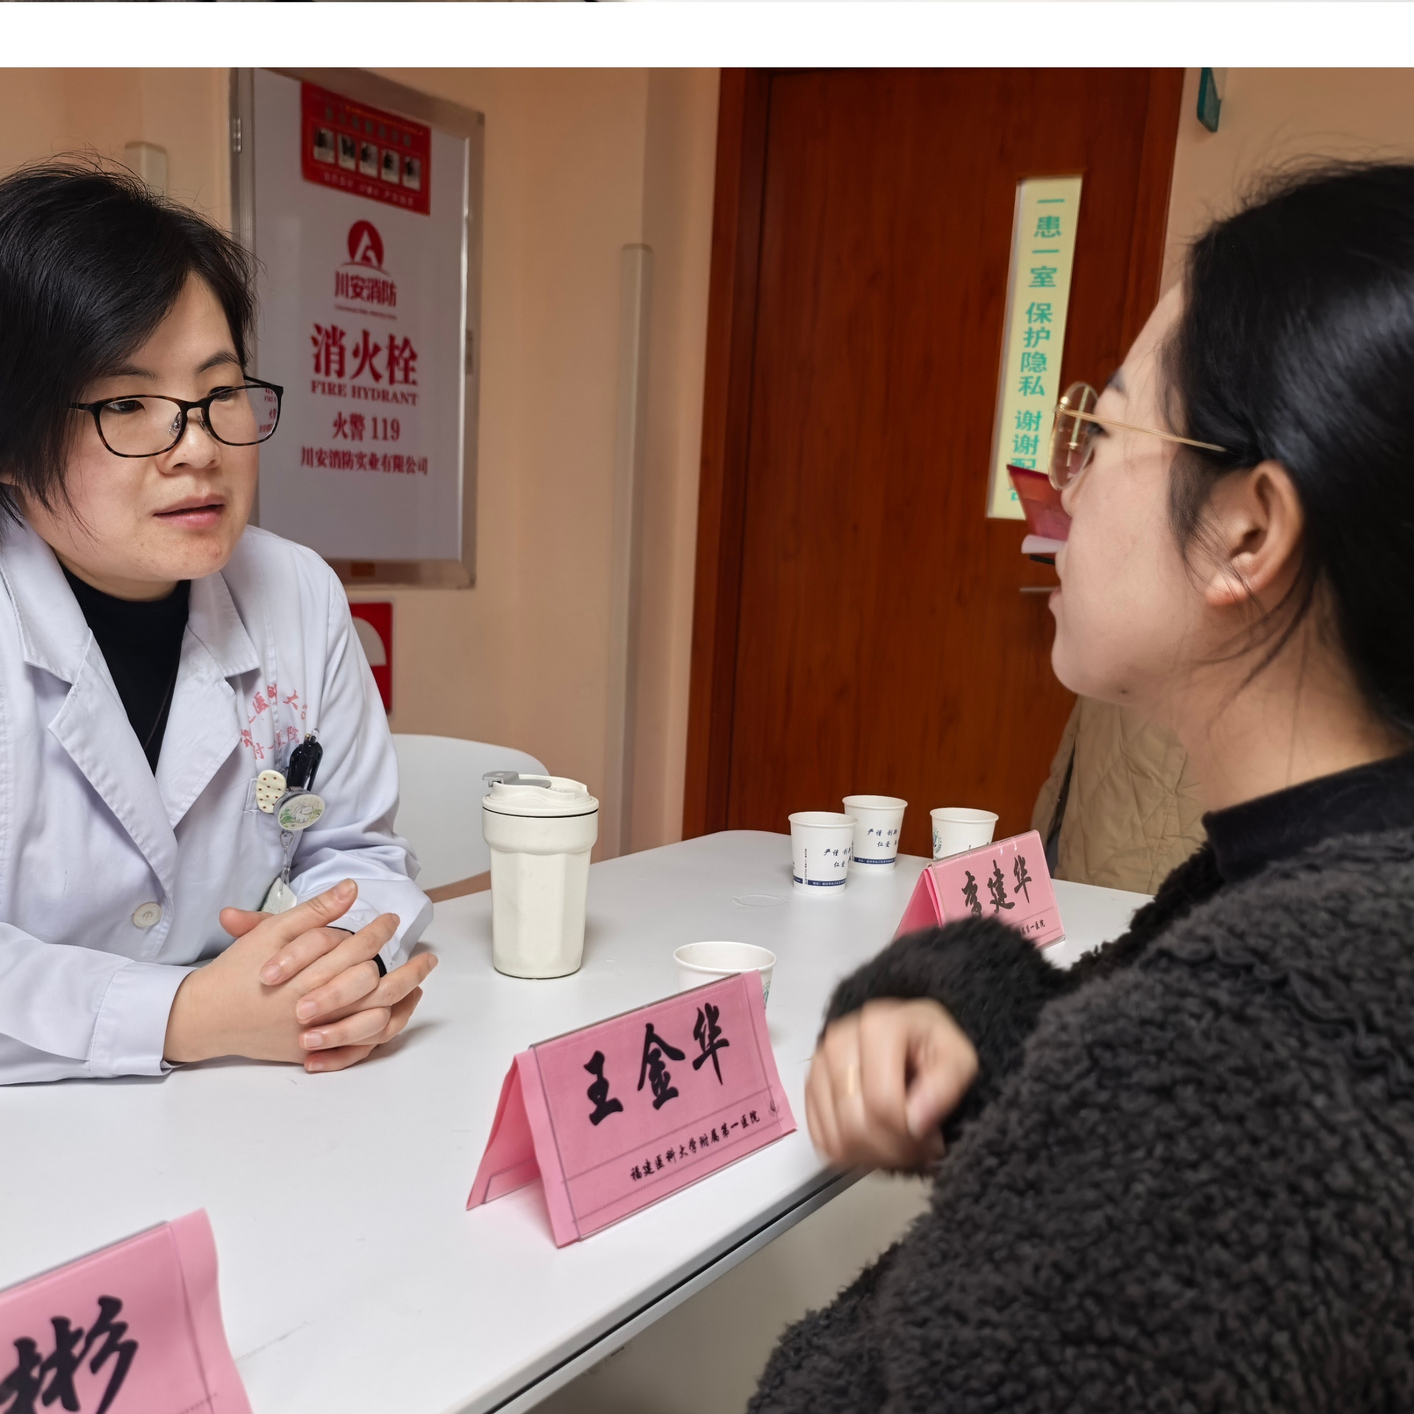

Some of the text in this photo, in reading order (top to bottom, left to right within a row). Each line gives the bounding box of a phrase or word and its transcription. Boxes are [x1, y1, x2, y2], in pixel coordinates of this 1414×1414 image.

[1028, 197, 1066, 289] 一患一室
[334, 270, 398, 308] 川安消防
[310, 322, 419, 387] 消火栓
[1017, 300, 1054, 398] 保护隐私
[311, 379, 419, 406] FIRE HYDRANT
[332, 411, 401, 442] 火警 119
[301, 446, 429, 476] 川安消防实业有限公司
[583, 1002, 730, 1126] 王金华
[630, 1109, 761, 1182] 福建医科大学附属第一医院
